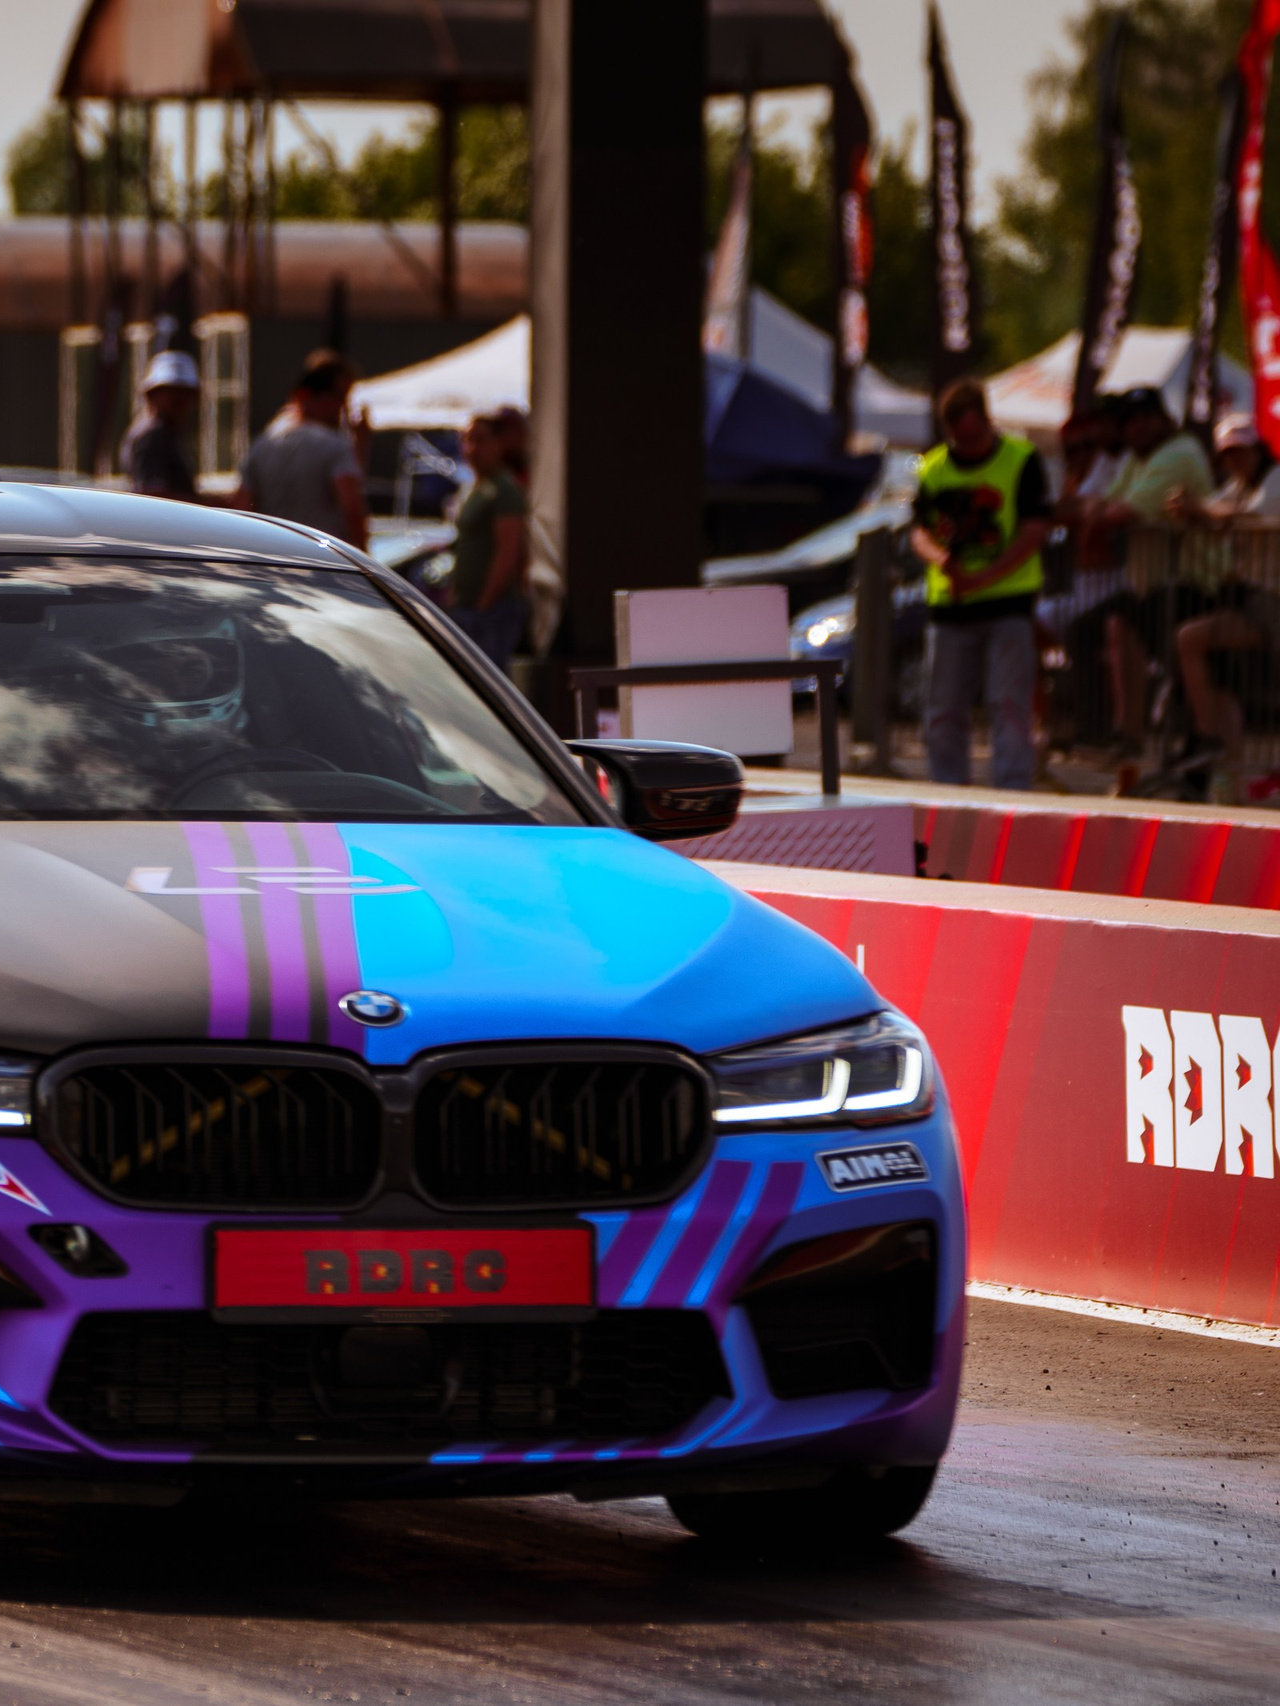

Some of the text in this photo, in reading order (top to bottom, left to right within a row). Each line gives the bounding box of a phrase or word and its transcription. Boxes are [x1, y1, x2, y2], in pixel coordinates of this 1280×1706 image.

[1121, 1004, 1280, 1180] RDR
[827, 1151, 927, 1184] AIMOL
[302, 1249, 507, 1294] RDRC
